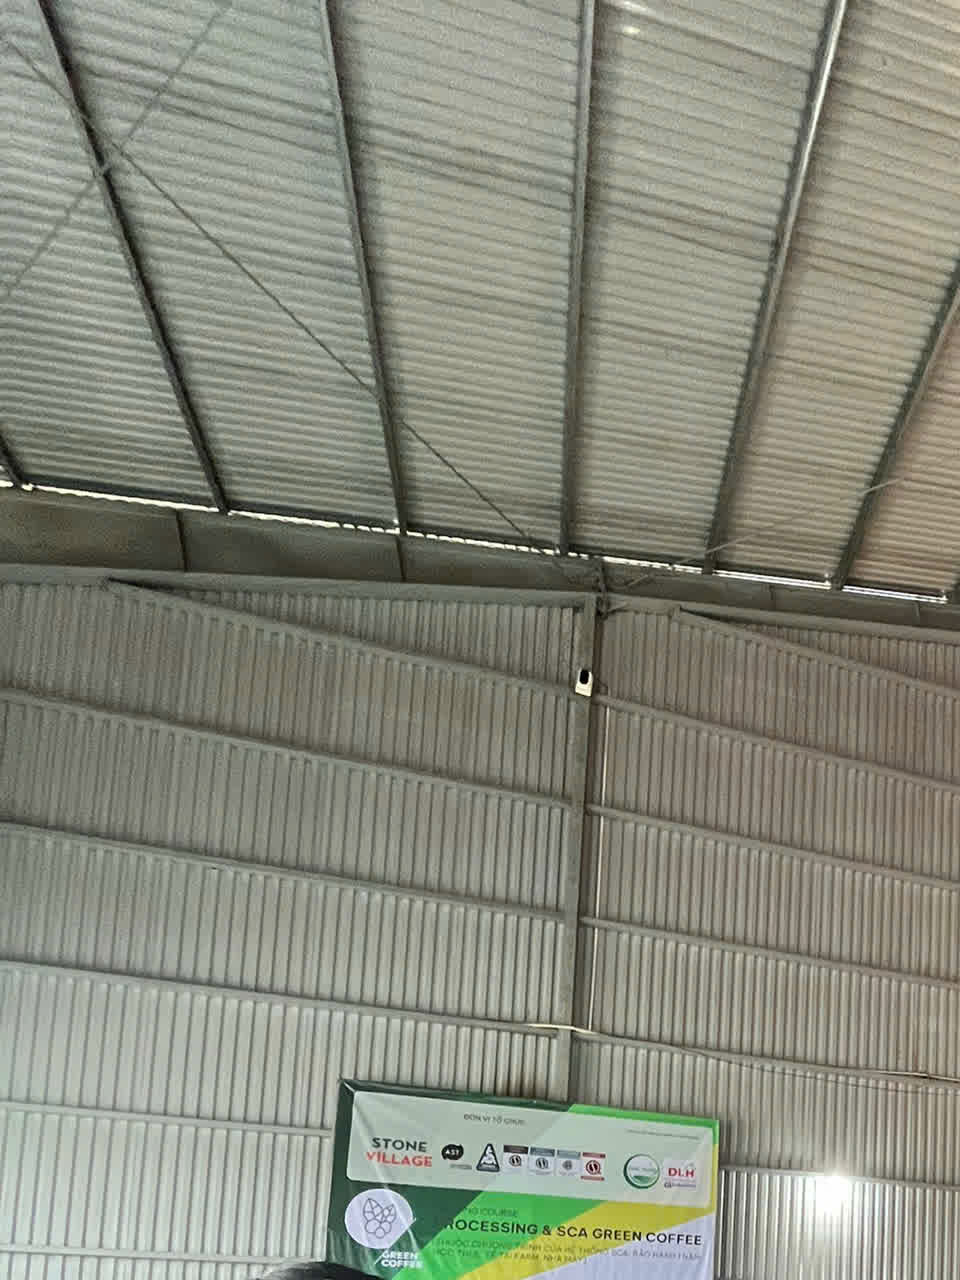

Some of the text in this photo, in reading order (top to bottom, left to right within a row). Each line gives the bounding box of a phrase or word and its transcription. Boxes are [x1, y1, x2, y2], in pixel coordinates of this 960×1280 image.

[371, 1136, 428, 1154] STONE
[366, 1150, 433, 1168] VILLAGE
[442, 1219, 703, 1247] ROCESSING & SCA GREEN COFFEE
[381, 1259, 424, 1269] COFFEE
[382, 1250, 421, 1260] GREEN
